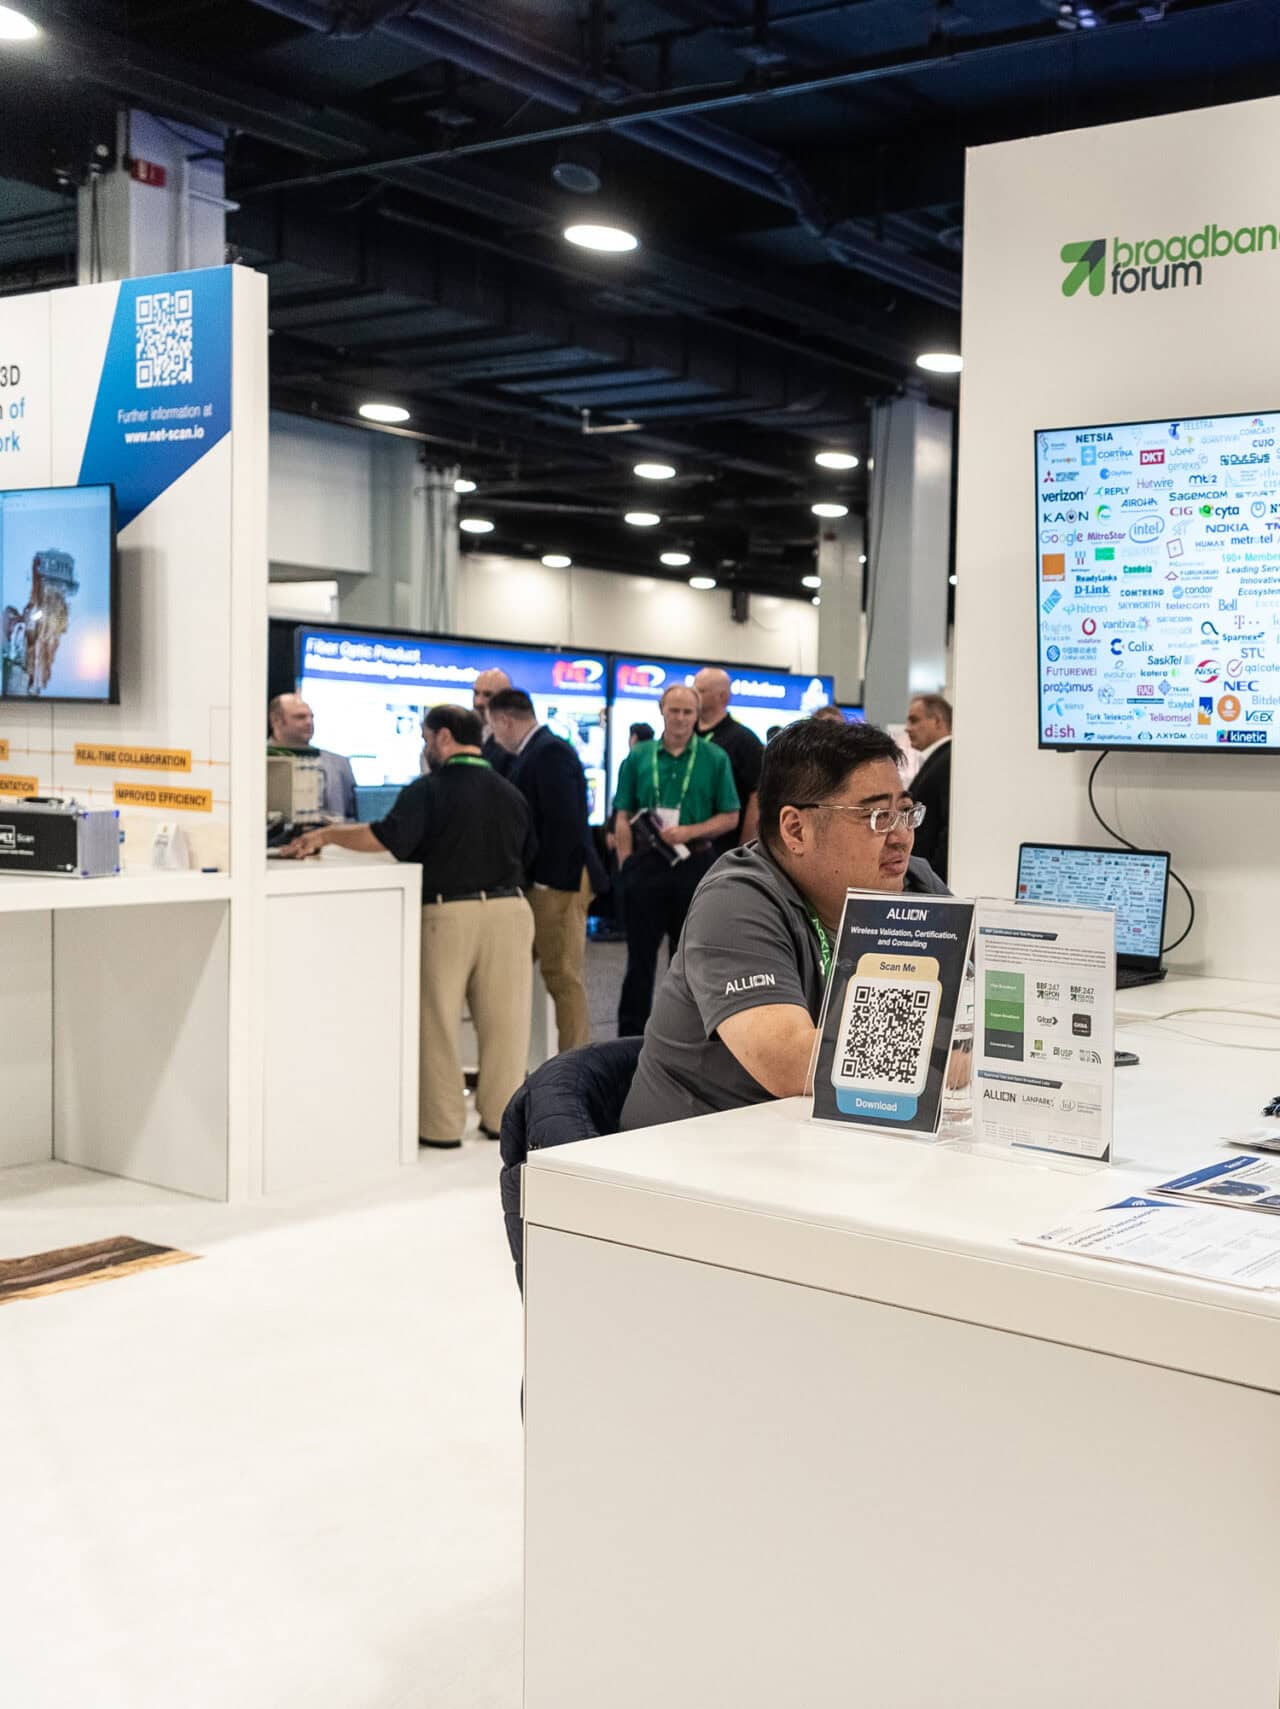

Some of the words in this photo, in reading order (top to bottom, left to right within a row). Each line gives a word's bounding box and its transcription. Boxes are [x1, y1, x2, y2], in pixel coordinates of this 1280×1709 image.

[1111, 259, 1202, 295] forum
[0, 365, 20, 387] 3D
[9, 396, 25, 419] of
[117, 408, 148, 424] Further
[151, 404, 201, 422] information
[203, 402, 213, 416] at
[124, 424, 205, 444] www.net-scan.io
[1075, 432, 1114, 443] NETSIA
[1252, 438, 1275, 448] CUJO
[1097, 447, 1134, 459] CORTINA
[1141, 451, 1163, 464] DKT
[1137, 478, 1173, 488] Hotwire
[1042, 490, 1084, 503] verizon
[1104, 487, 1129, 496] REPLY
[1170, 506, 1193, 516] CIG
[1215, 505, 1240, 519] cyta
[1134, 521, 1160, 536] intel
[1206, 523, 1249, 533] NOKIA
[1041, 529, 1083, 546] Google
[1222, 552, 1241, 562] 190+
[1226, 565, 1259, 576] Leading
[1075, 585, 1110, 595] D-Link
[1218, 600, 1238, 611] Bell
[1222, 633, 1258, 643] Sparnex
[1128, 641, 1154, 652] Calix
[1147, 656, 1183, 665] SaskTel
[1223, 680, 1260, 692] NEC
[1149, 713, 1192, 722] Telkomsel
[1231, 731, 1266, 743] kinetic
[76, 749, 116, 764] REAL-TIME
[118, 752, 187, 768] COLLABORATION
[115, 788, 156, 803] IMPROVED
[158, 791, 207, 807] EFFICIENCY
[886, 908, 928, 921] ALLION
[851, 926, 878, 936] Wireless
[879, 928, 913, 938] Validation,
[914, 930, 958, 941] Certification,
[877, 938, 890, 946] and
[891, 939, 928, 950] Consulting
[879, 961, 900, 972] Scan
[902, 963, 917, 973] Me
[725, 973, 776, 995] ALLION
[983, 1089, 1016, 1103] ALLION
[855, 1098, 897, 1112] Download
